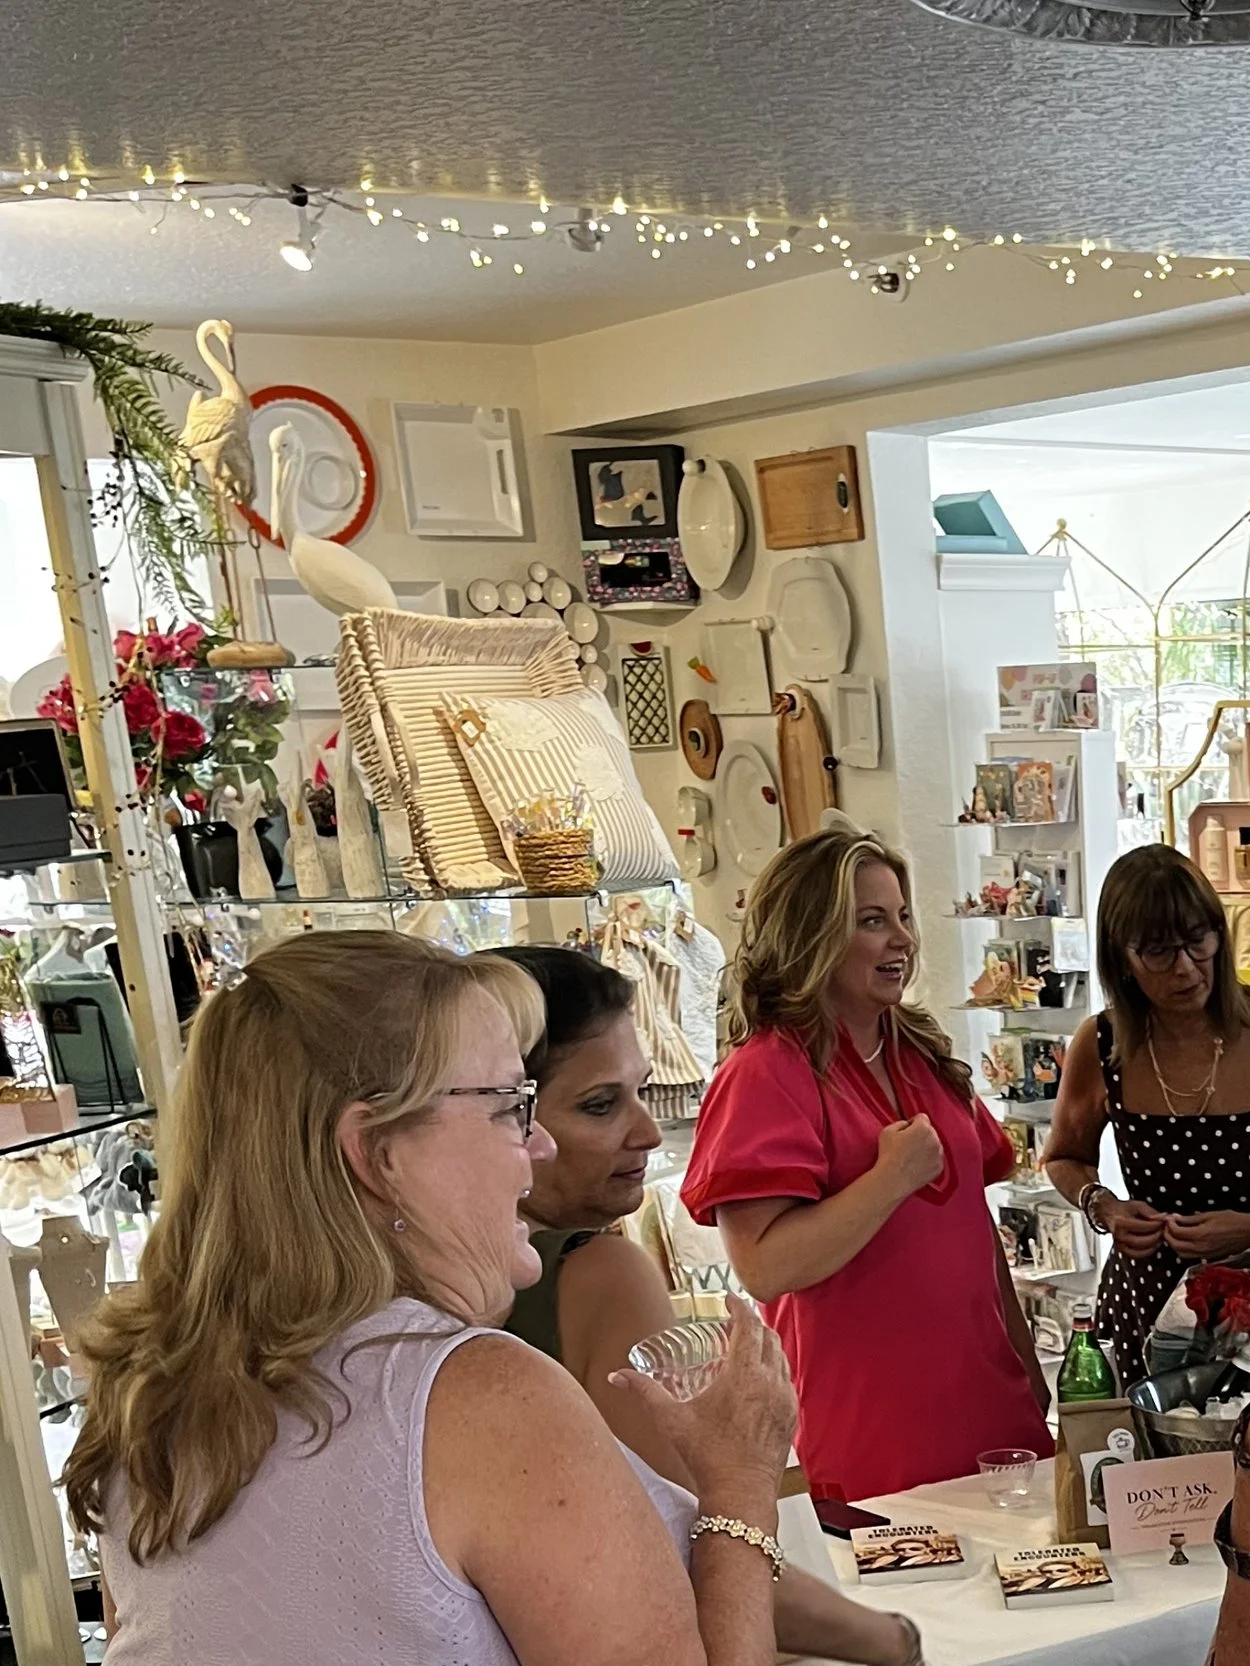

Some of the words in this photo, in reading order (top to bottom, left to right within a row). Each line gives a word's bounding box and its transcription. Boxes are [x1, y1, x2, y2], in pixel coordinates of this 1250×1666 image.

[1126, 1485, 1179, 1505] DON'T
[1182, 1496, 1209, 1516] Tell
[868, 1529, 939, 1539] ENCOUNTERS
[872, 1525, 934, 1535] TOLERATED
[1013, 1551, 1086, 1562] ENCOUNTERS
[1017, 1547, 1080, 1557] TOLERATED
